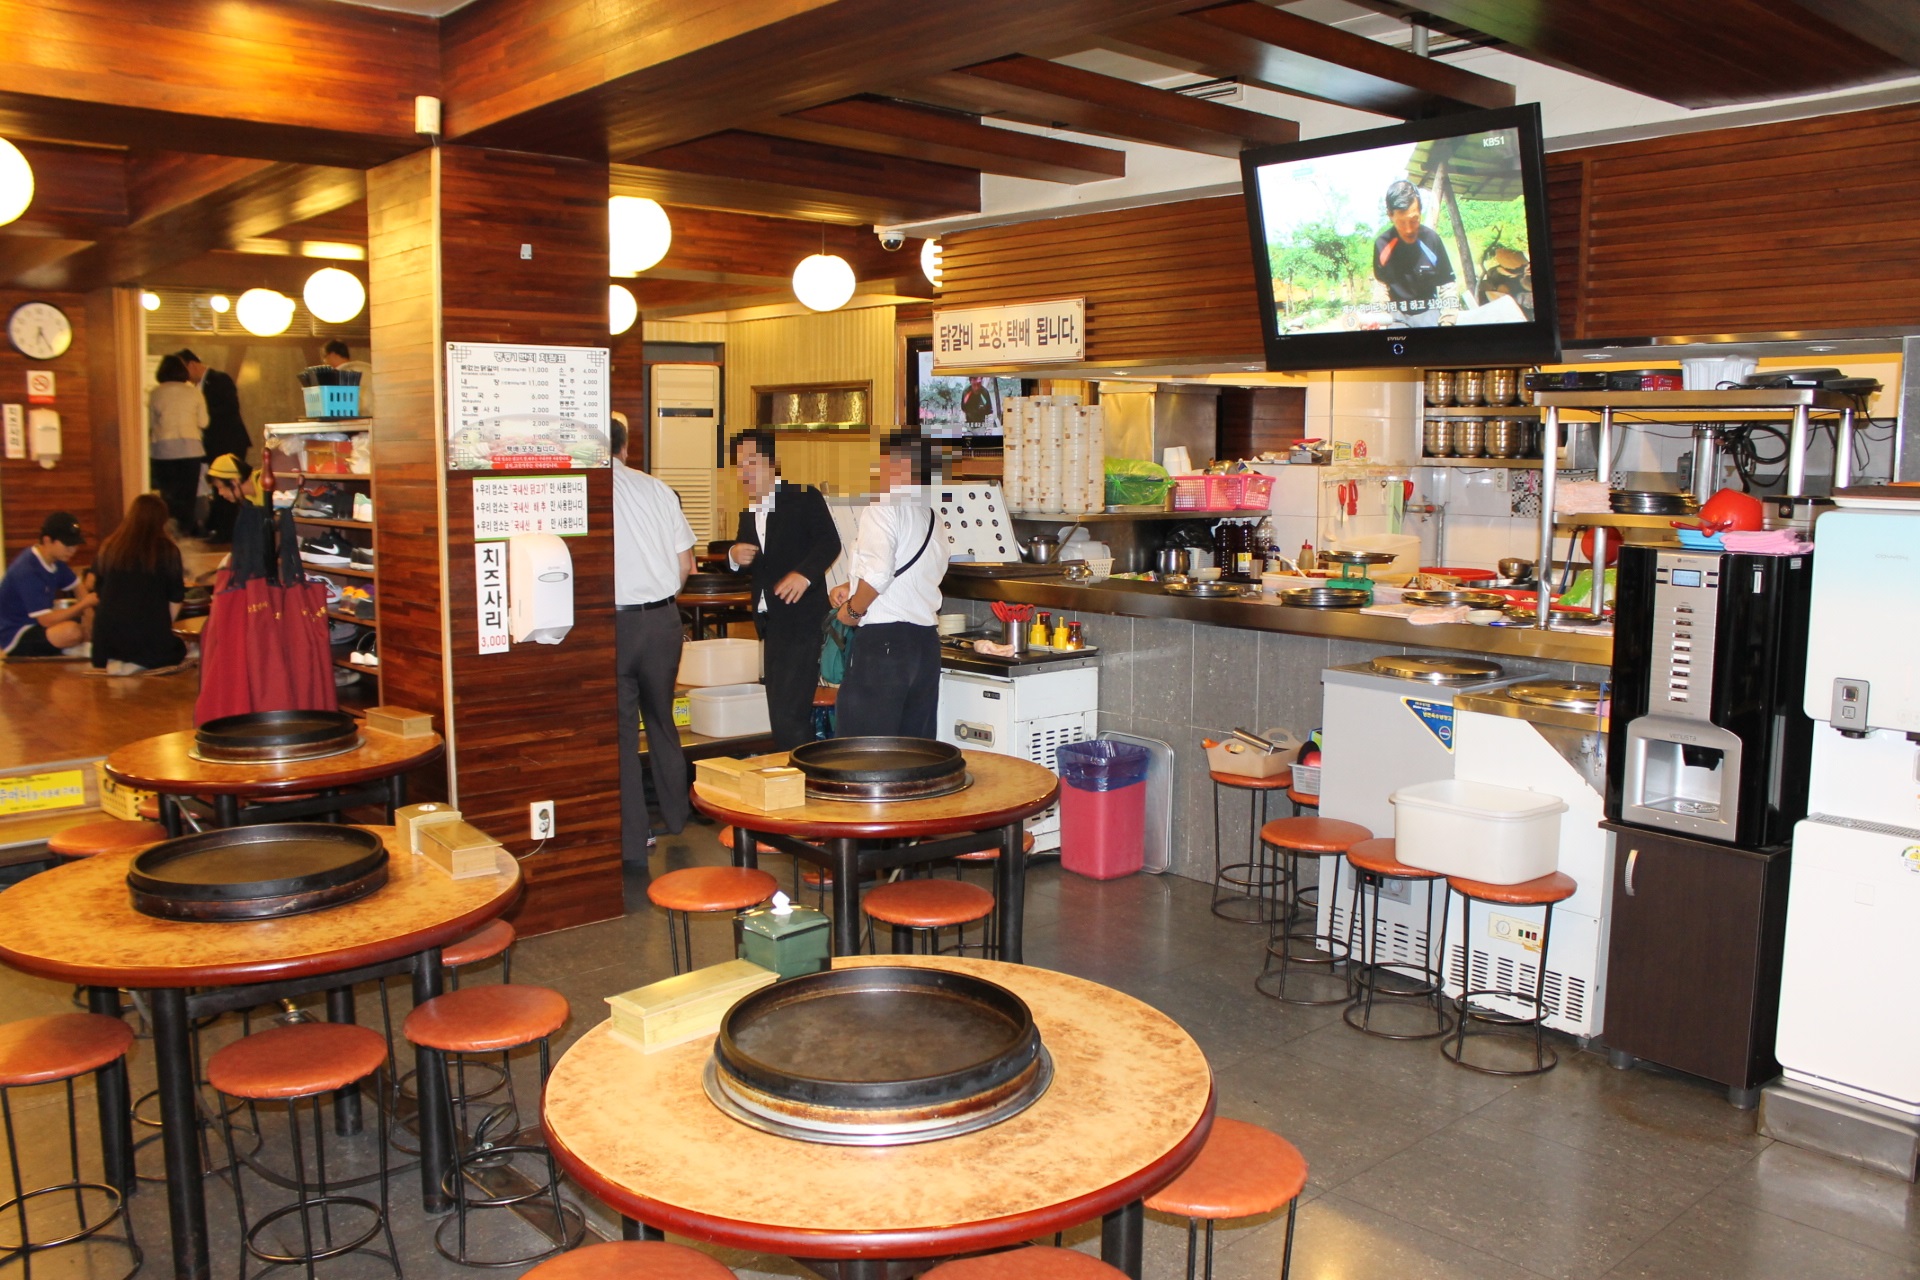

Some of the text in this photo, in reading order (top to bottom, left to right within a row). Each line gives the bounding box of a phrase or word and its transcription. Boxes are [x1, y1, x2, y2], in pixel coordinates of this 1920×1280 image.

[1483, 136, 1504, 147] KBS1
[1410, 299, 1426, 310] 하고
[940, 322, 973, 352] 닭갈비
[1036, 314, 1078, 346] 됩니다.
[480, 484, 490, 495] 우리
[492, 484, 508, 495] 업소는
[480, 502, 491, 514] 우리
[493, 502, 509, 514] 업소는
[481, 520, 491, 532] 우리
[494, 520, 510, 532] 업소는
[483, 548, 502, 629] 치즈사리
[481, 635, 507, 648] 3,000
